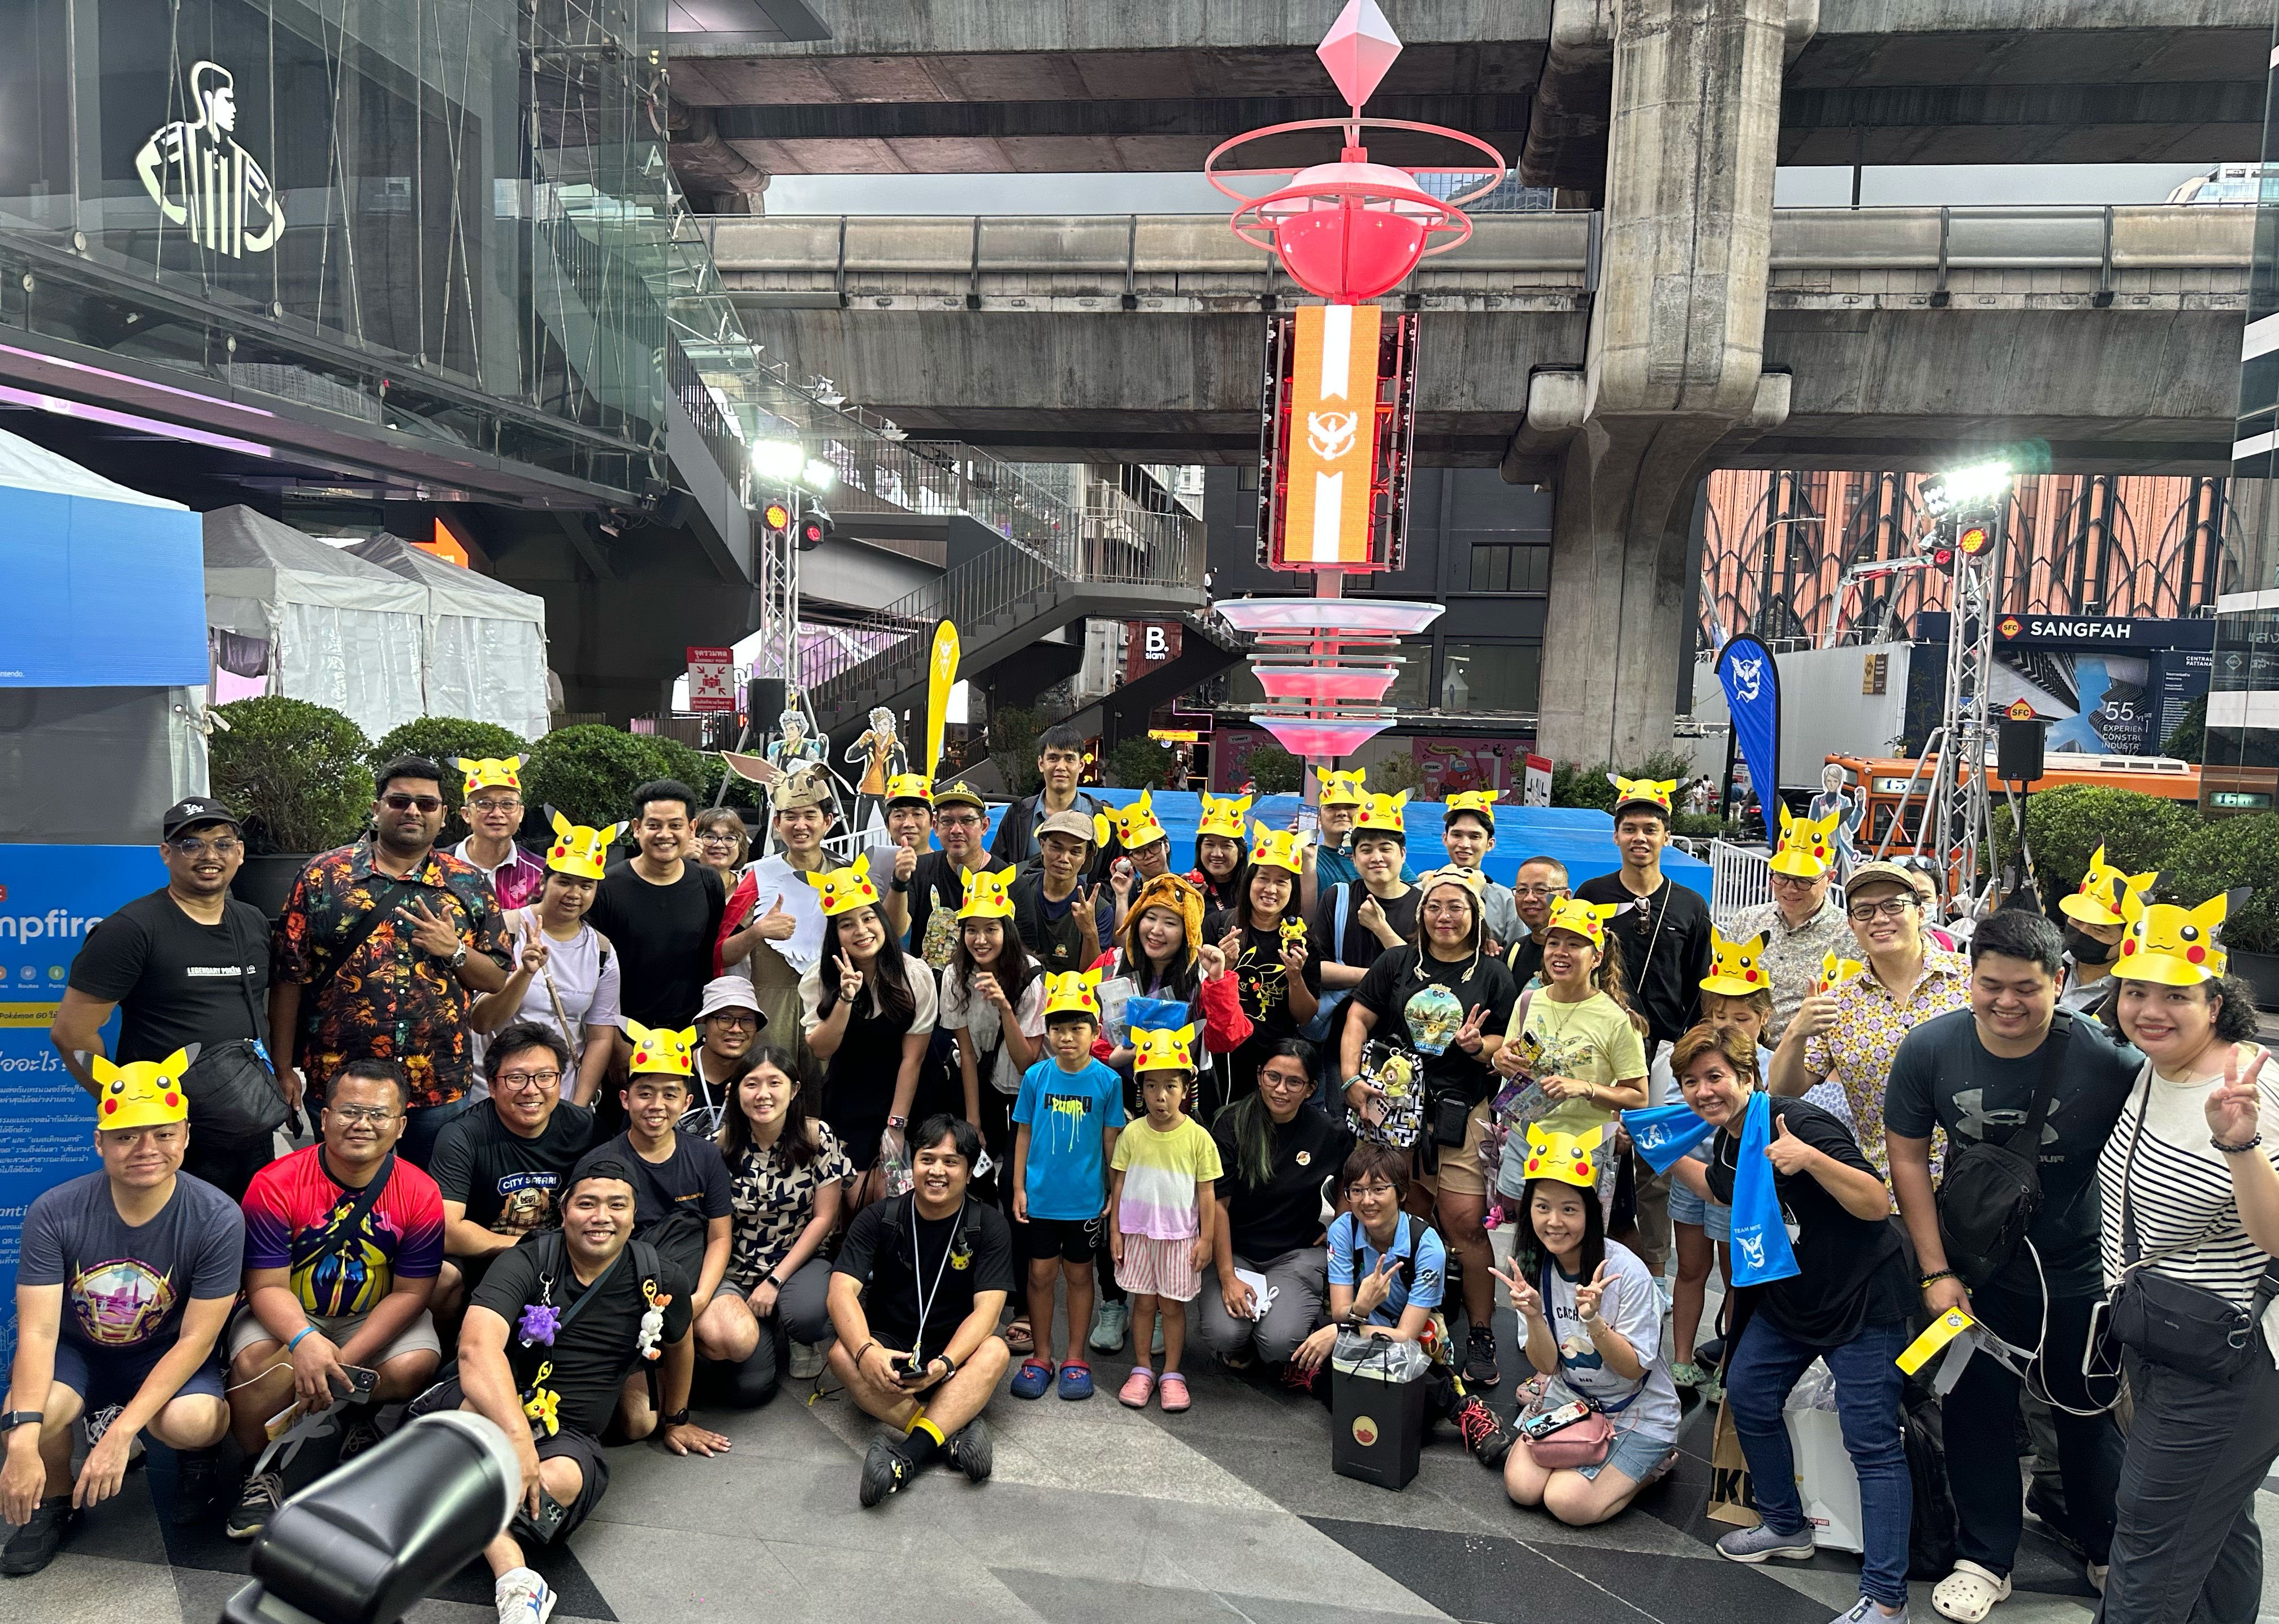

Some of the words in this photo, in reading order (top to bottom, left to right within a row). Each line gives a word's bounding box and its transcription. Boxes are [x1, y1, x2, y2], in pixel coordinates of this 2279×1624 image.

[2030, 622, 2130, 638] SANGFAH
[1146, 627, 1169, 652] B.
[694, 650, 727, 659] จุดรวมพล
[1145, 651, 1166, 660] siam
[2105, 702, 2134, 720] 55
[502, 1177, 523, 1189] CITY
